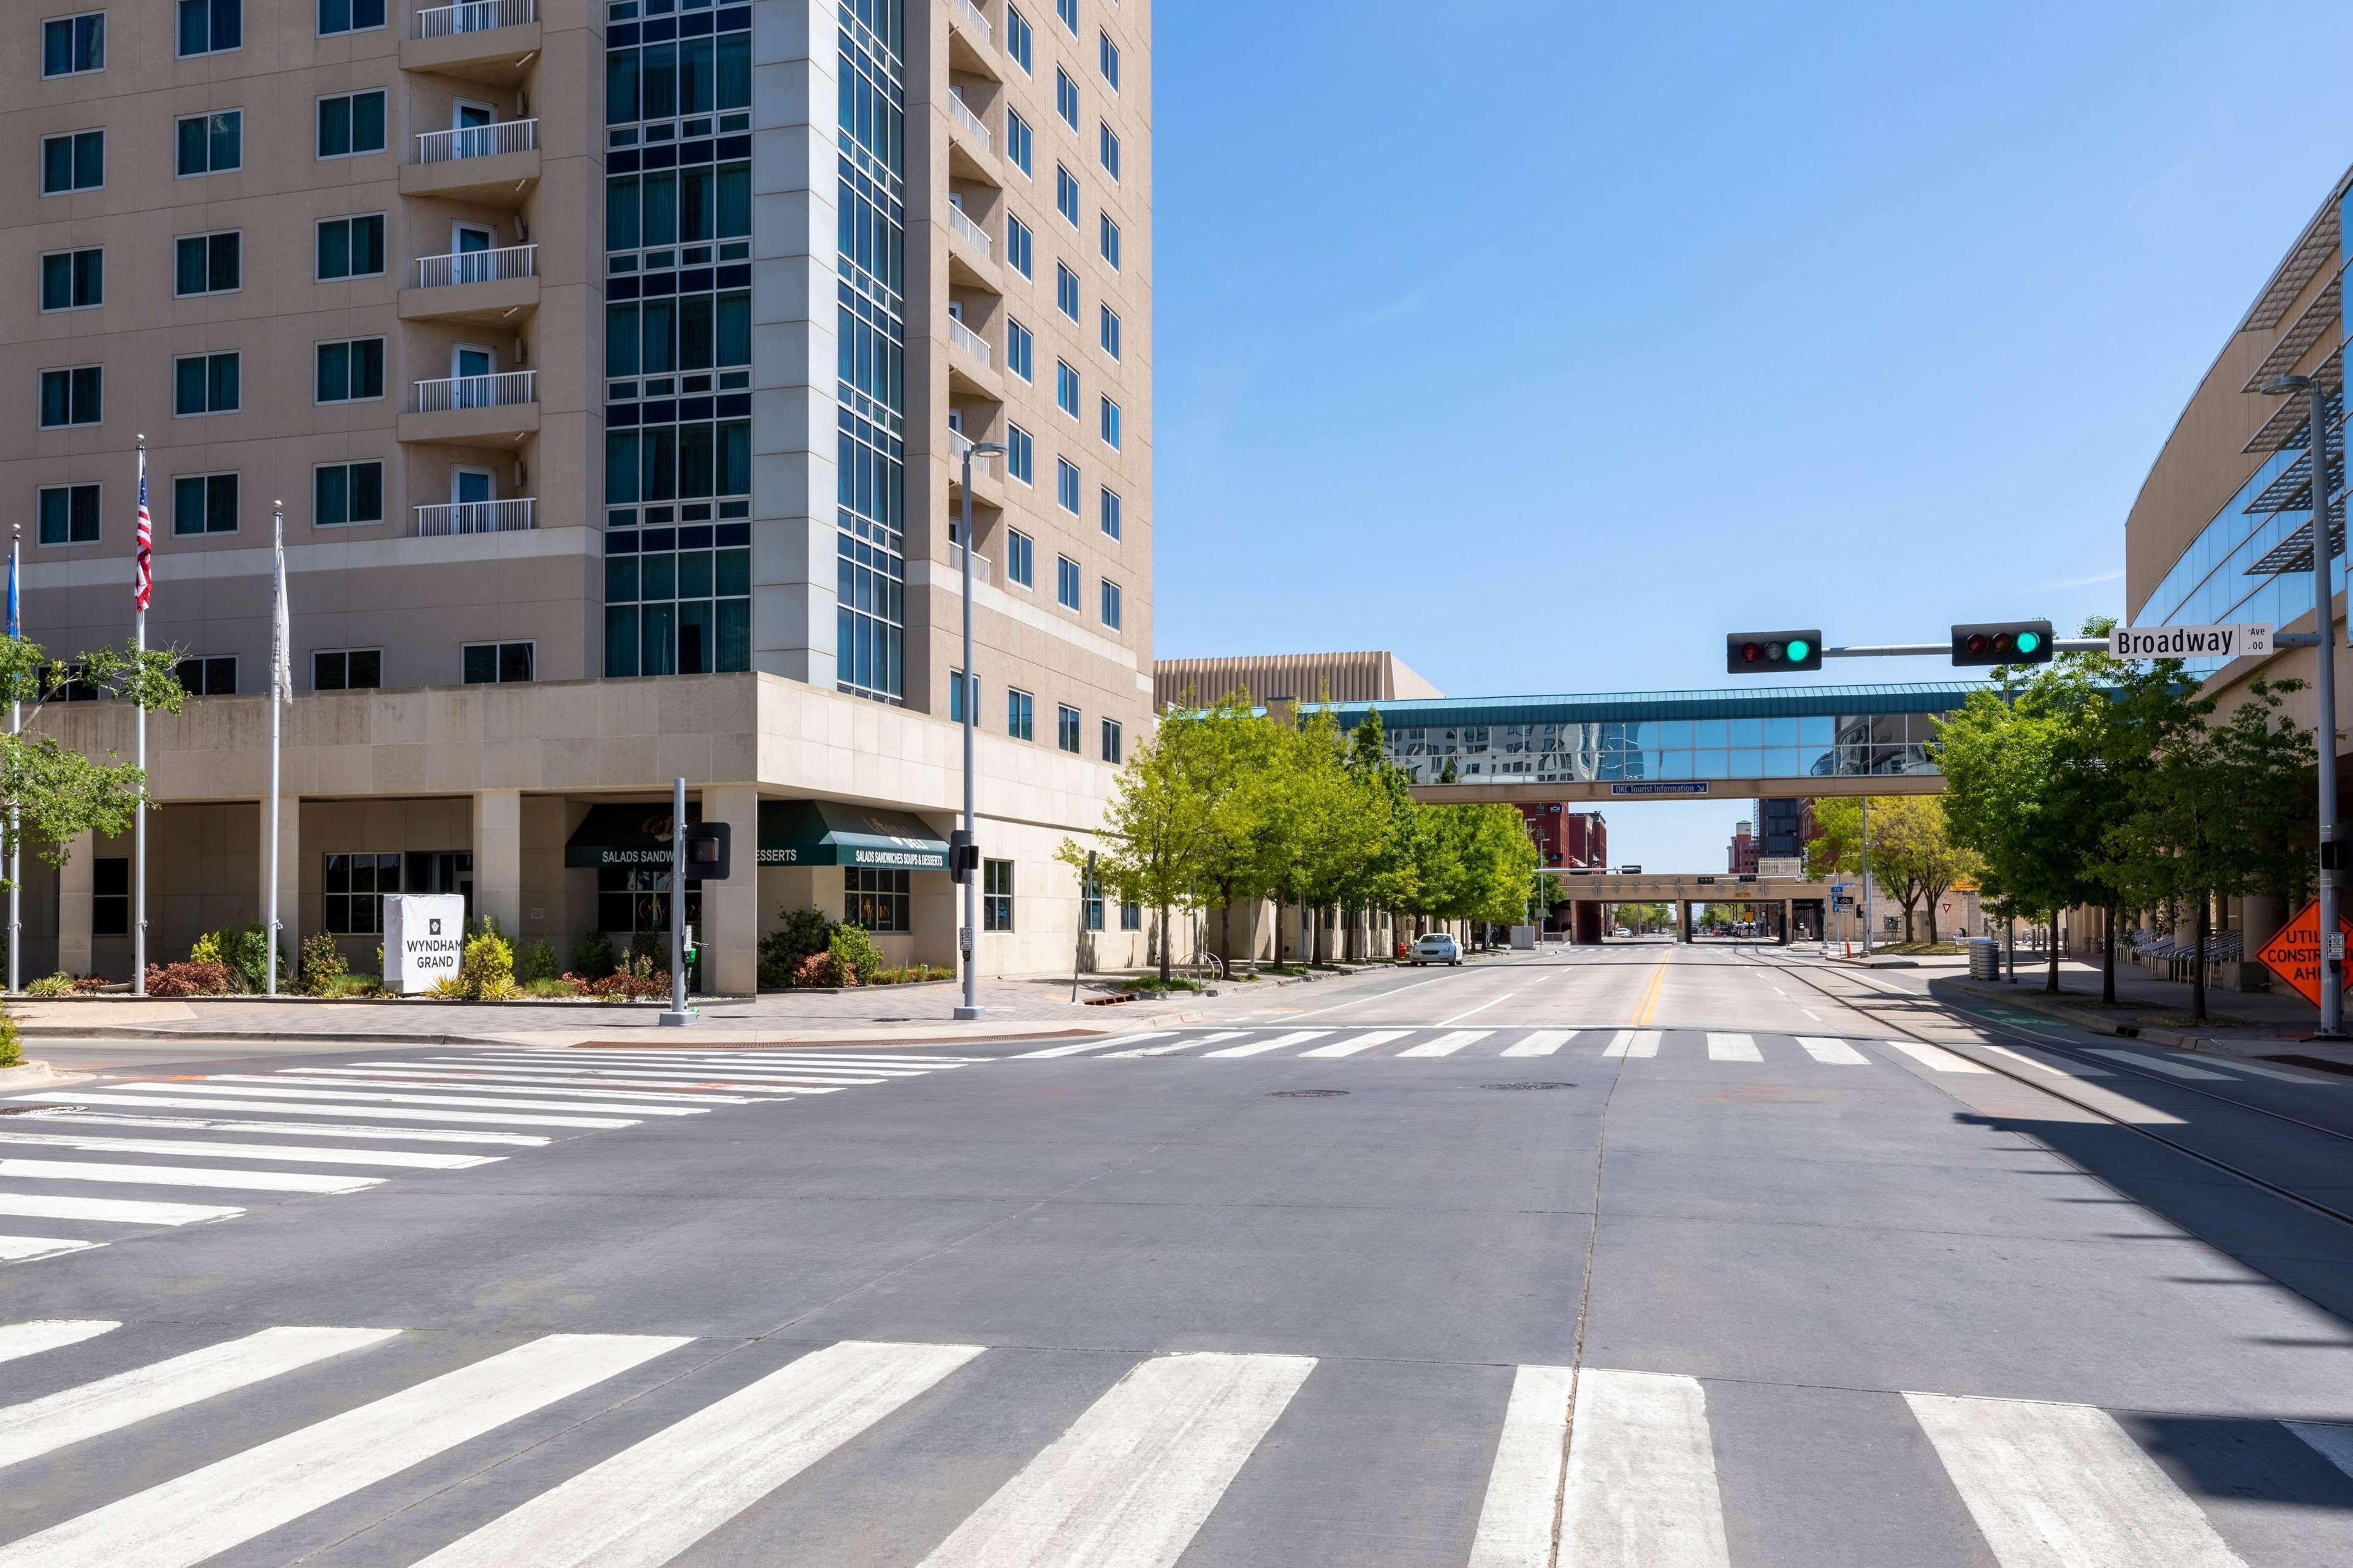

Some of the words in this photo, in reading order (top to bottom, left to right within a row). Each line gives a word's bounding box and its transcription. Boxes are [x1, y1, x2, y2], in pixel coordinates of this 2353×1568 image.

[2118, 628, 2233, 656] Broadway
[2250, 627, 2265, 636] Ave
[1616, 785, 1629, 793] OKC
[1630, 785, 1652, 793] Tourist
[1654, 784, 1694, 793] Information
[902, 837, 929, 850] DELI
[602, 850, 639, 863] SALADS
[641, 850, 674, 863] SANDW
[756, 849, 797, 862] ESSERTS
[856, 850, 875, 863] SALADS
[875, 851, 903, 865] SANDWICHES
[903, 853, 918, 865] SOUPS
[918, 854, 922, 865] &
[922, 854, 943, 866] DESSERTS
[2286, 930, 2352, 944] UTILY
[407, 939, 462, 952] WYNDHAM
[417, 956, 454, 969] GRAND
[2294, 967, 2349, 980] AHD
